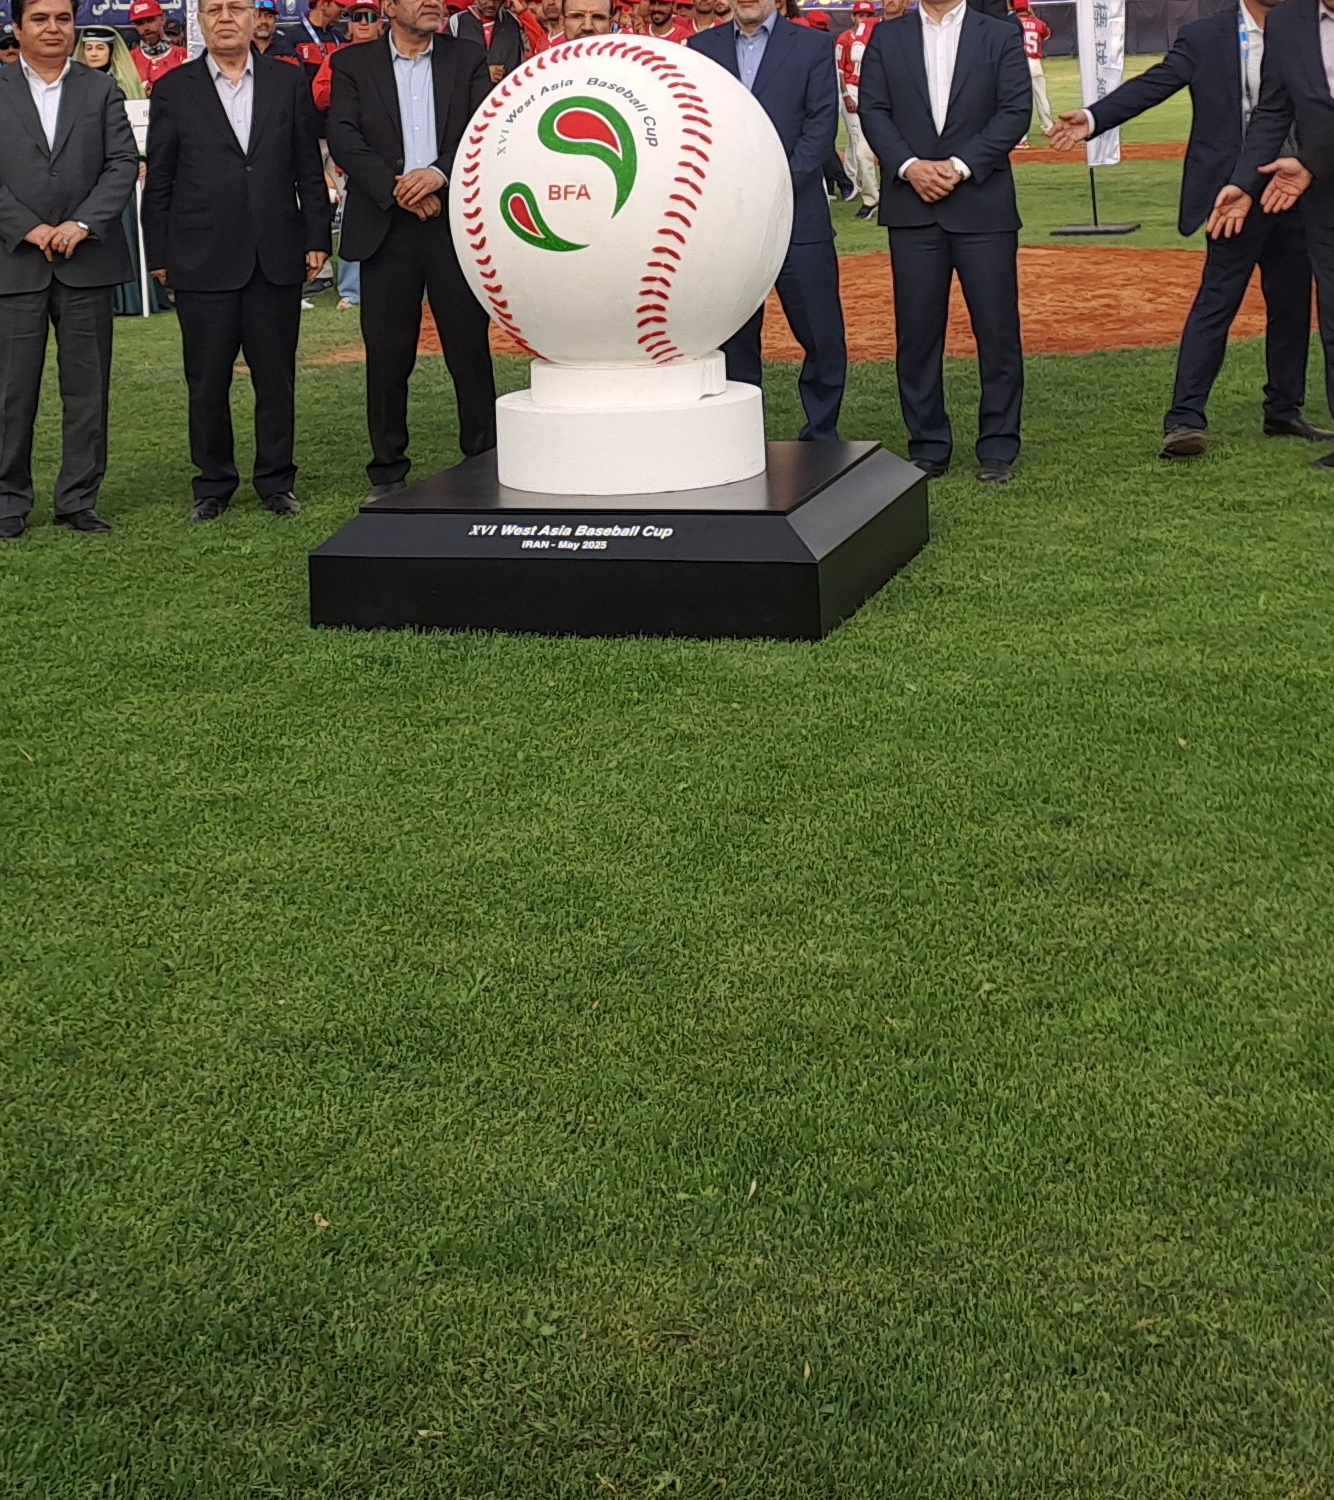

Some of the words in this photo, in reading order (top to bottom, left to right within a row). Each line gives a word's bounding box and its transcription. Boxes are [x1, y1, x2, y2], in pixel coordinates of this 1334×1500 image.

[496, 129, 510, 156] XVI
[505, 94, 536, 124] West
[540, 79, 574, 96] Asia
[586, 77, 648, 112] Baseball
[643, 115, 659, 147] Cup
[548, 184, 592, 201] BFA
[468, 525, 498, 536] XVI
[500, 525, 538, 536] West
[538, 525, 572, 536] Asia
[575, 525, 641, 536] Baseball
[642, 526, 674, 539] Cup
[521, 540, 550, 549] IRAN
[557, 541, 581, 551] May
[581, 541, 608, 549] 2025
